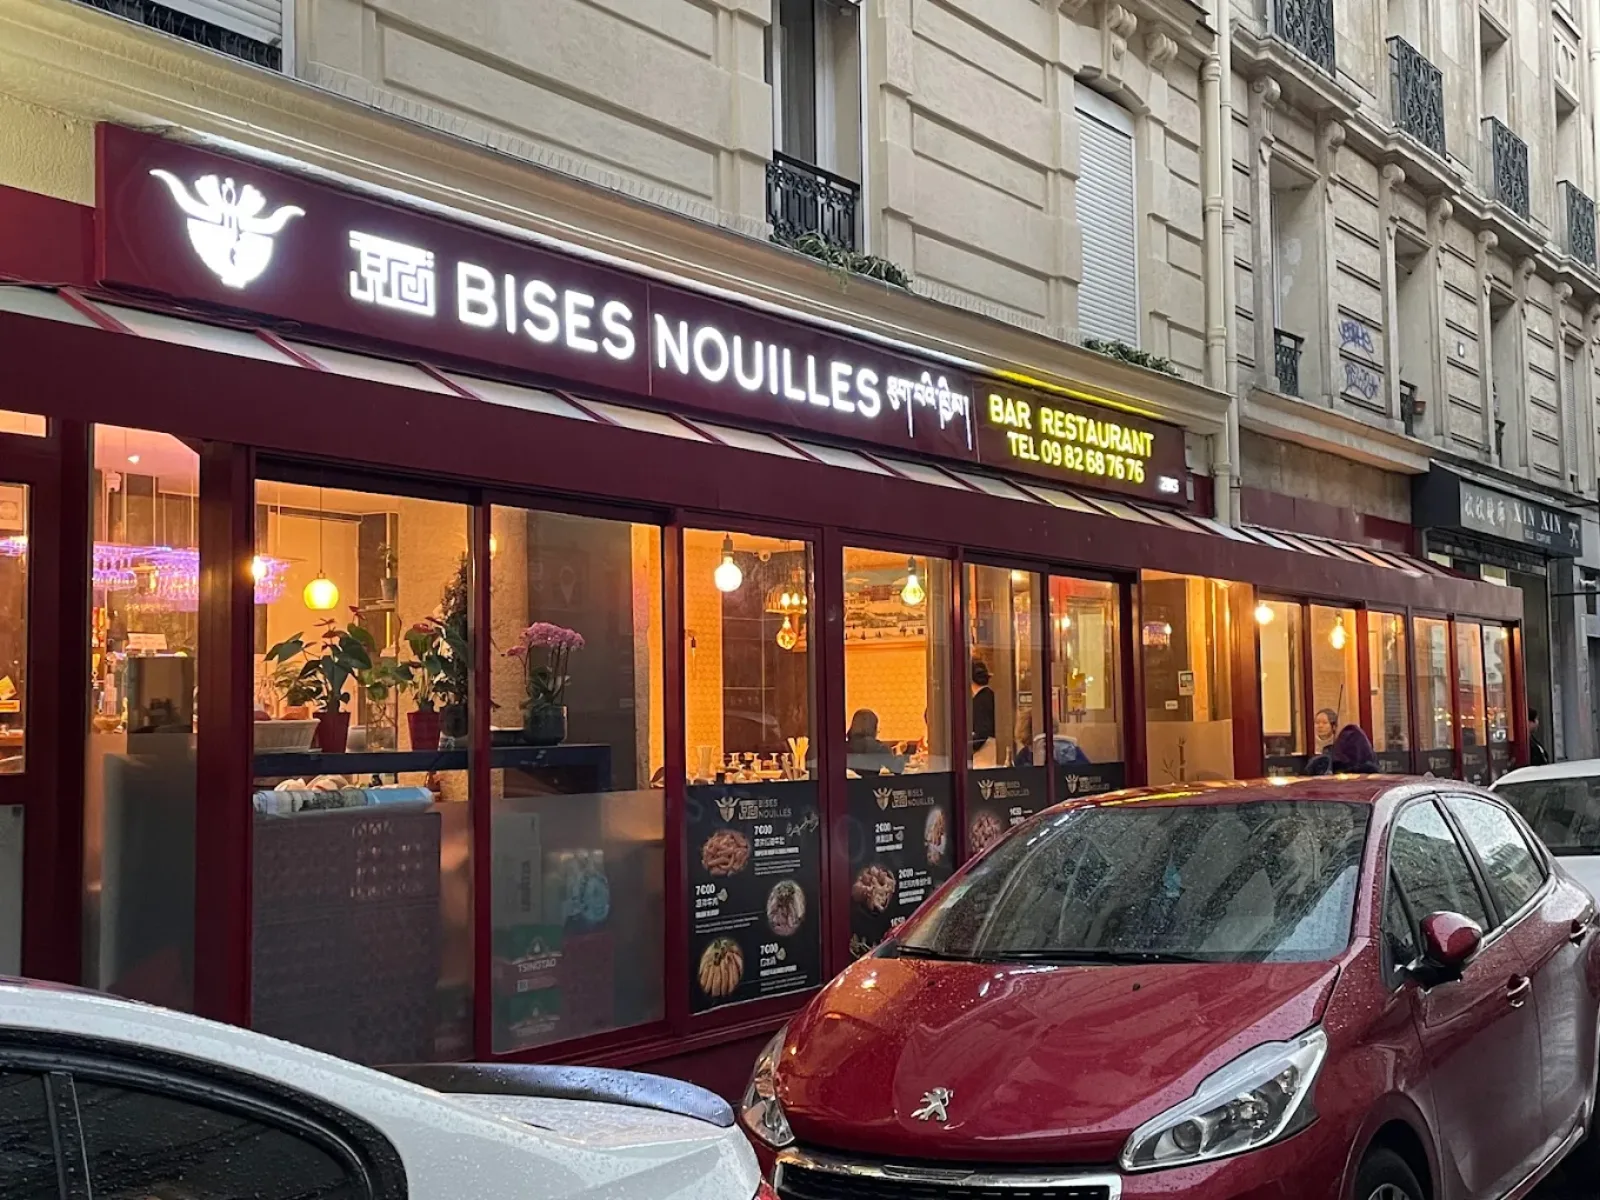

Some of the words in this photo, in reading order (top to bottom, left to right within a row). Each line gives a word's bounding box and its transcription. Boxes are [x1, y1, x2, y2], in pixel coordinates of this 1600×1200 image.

[456, 261, 636, 361] BISES
[653, 312, 882, 419] NOUILLES
[988, 393, 1032, 430] BAR
[1040, 406, 1155, 458] RESTAURANT
[1007, 431, 1040, 461] TEL
[1041, 439, 1062, 467] 09
[1064, 444, 1085, 471] 82
[1085, 450, 1106, 475] 68
[1106, 453, 1126, 480] 76
[1125, 457, 1146, 484] 76
[1513, 501, 1535, 526] XIN
[1540, 510, 1561, 535] XIN
[518, 958, 557, 973] TSINGTAO
